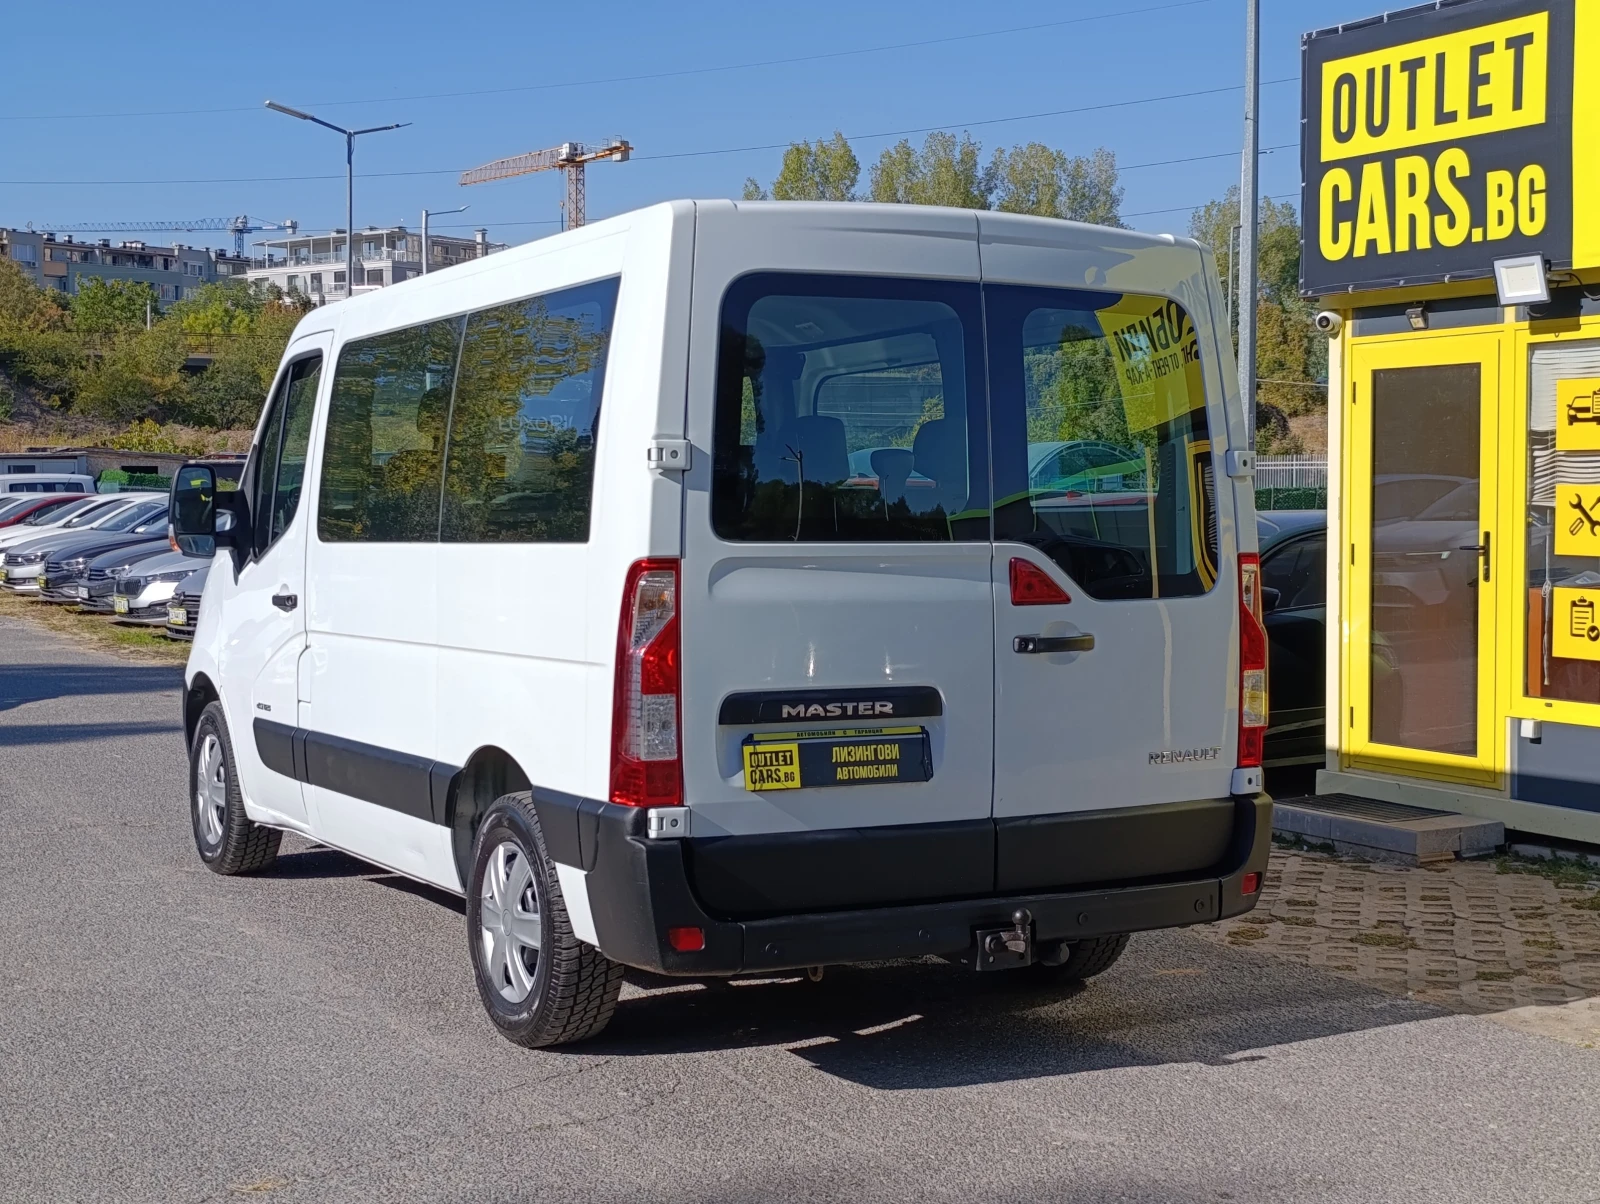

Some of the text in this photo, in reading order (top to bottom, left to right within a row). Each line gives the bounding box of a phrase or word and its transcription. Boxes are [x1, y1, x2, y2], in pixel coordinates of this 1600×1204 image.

[1332, 31, 1534, 144] OUTLET
[1319, 147, 1546, 261] CARS.BG
[782, 701, 893, 718] MASTER
[751, 752, 792, 767] OUTLET
[832, 744, 900, 763] ЛИЗИНГОВИ
[1148, 745, 1221, 765] RENAULT
[750, 768, 796, 785] CARS.BG
[836, 763, 898, 780] АВТОМОБИЛИ
